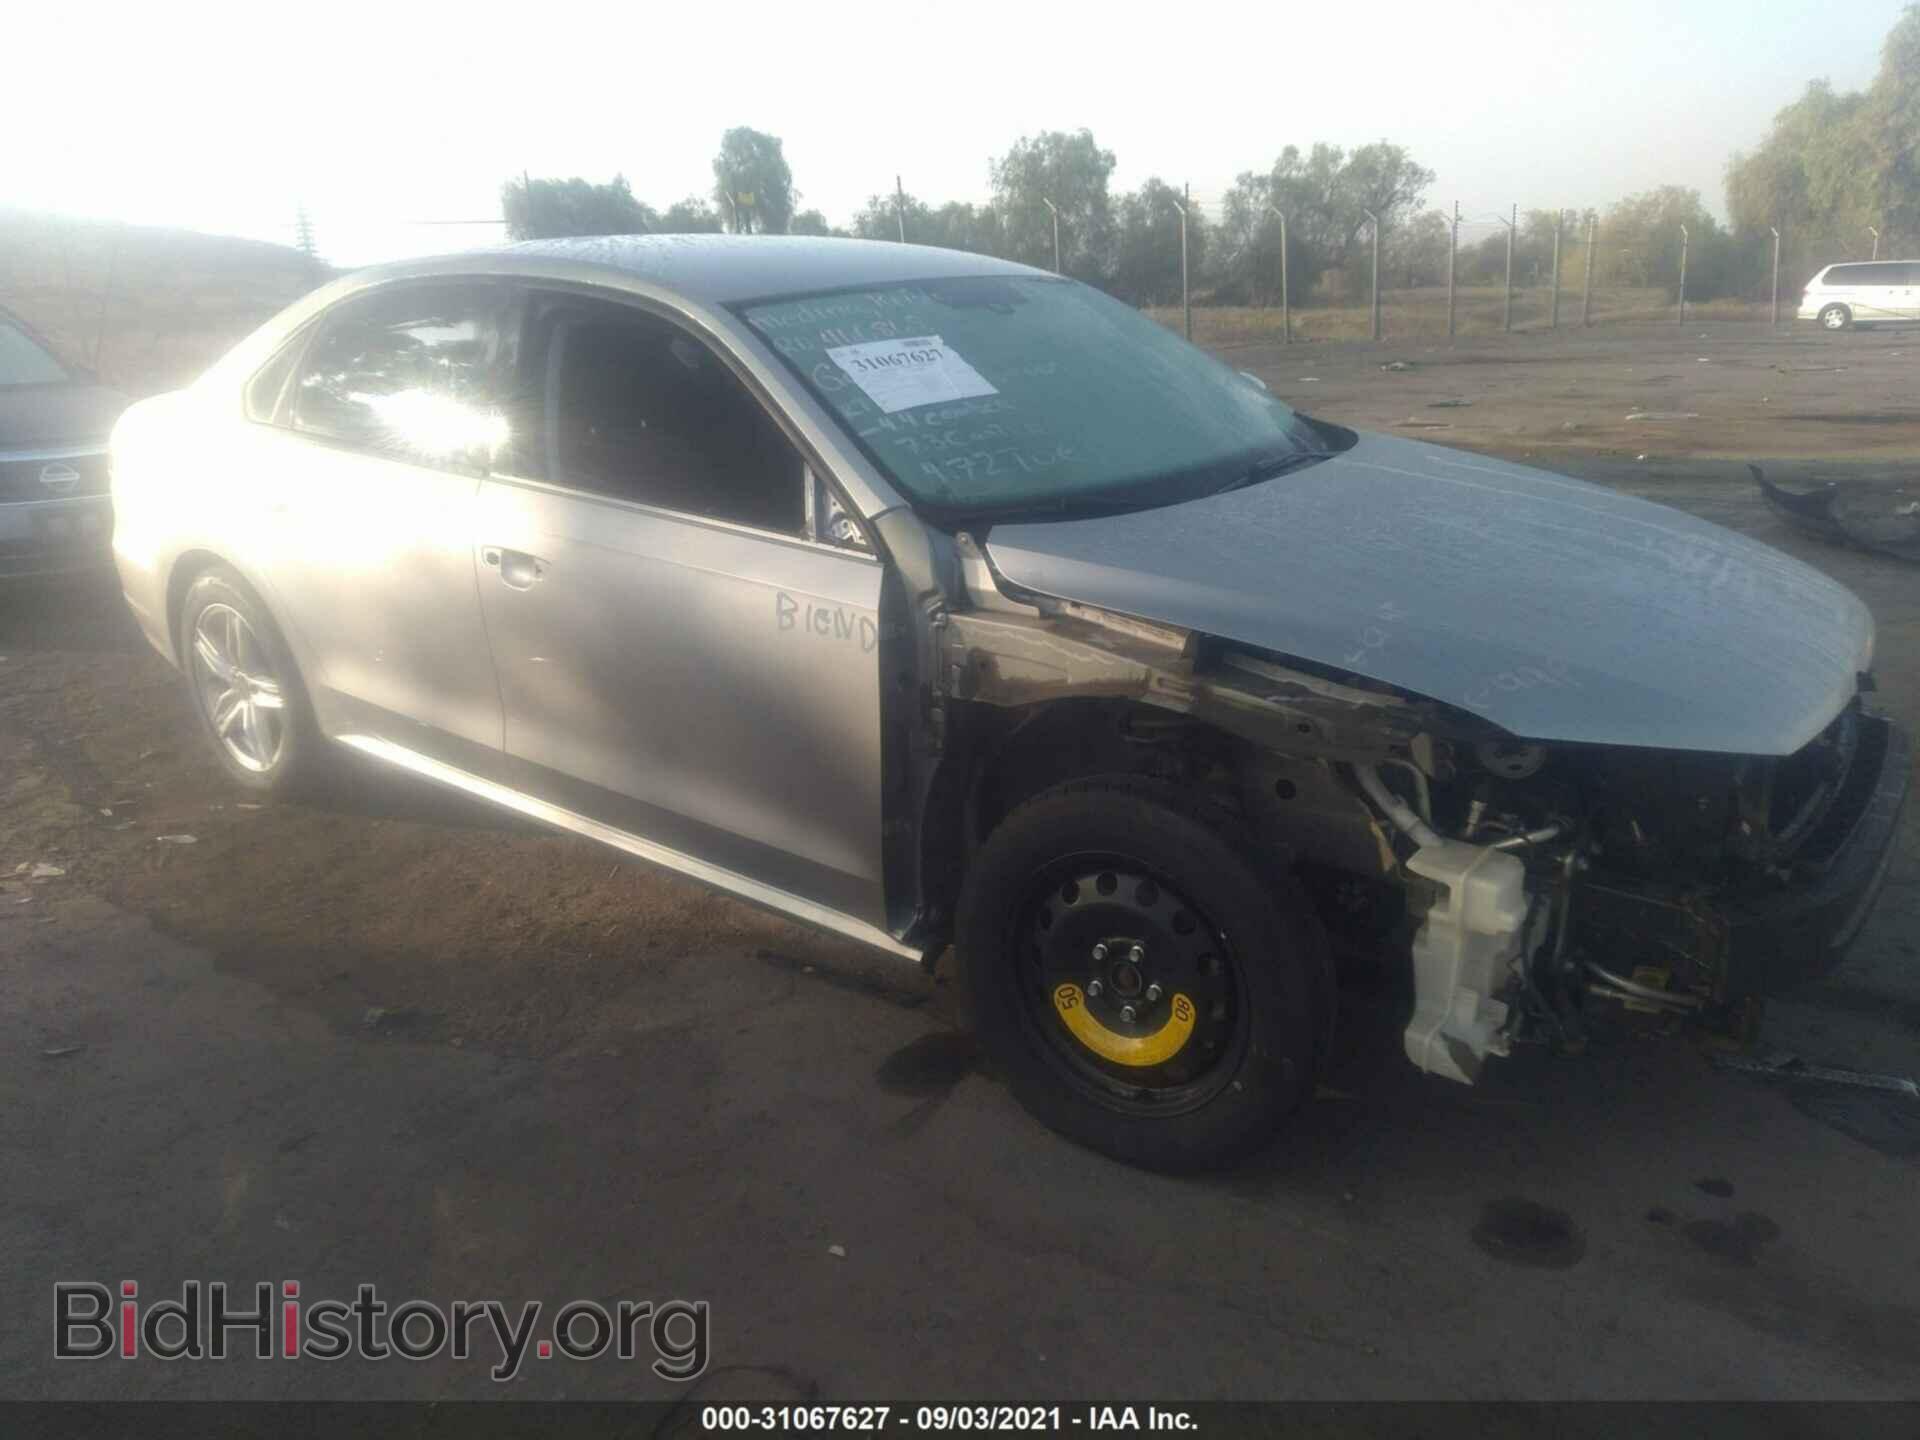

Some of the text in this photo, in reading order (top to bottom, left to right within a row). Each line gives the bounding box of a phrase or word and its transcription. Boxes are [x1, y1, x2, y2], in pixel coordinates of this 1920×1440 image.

[852, 347, 945, 371] 31067627
[1057, 986, 1079, 1011] 50
[1174, 996, 1191, 1023] 80
